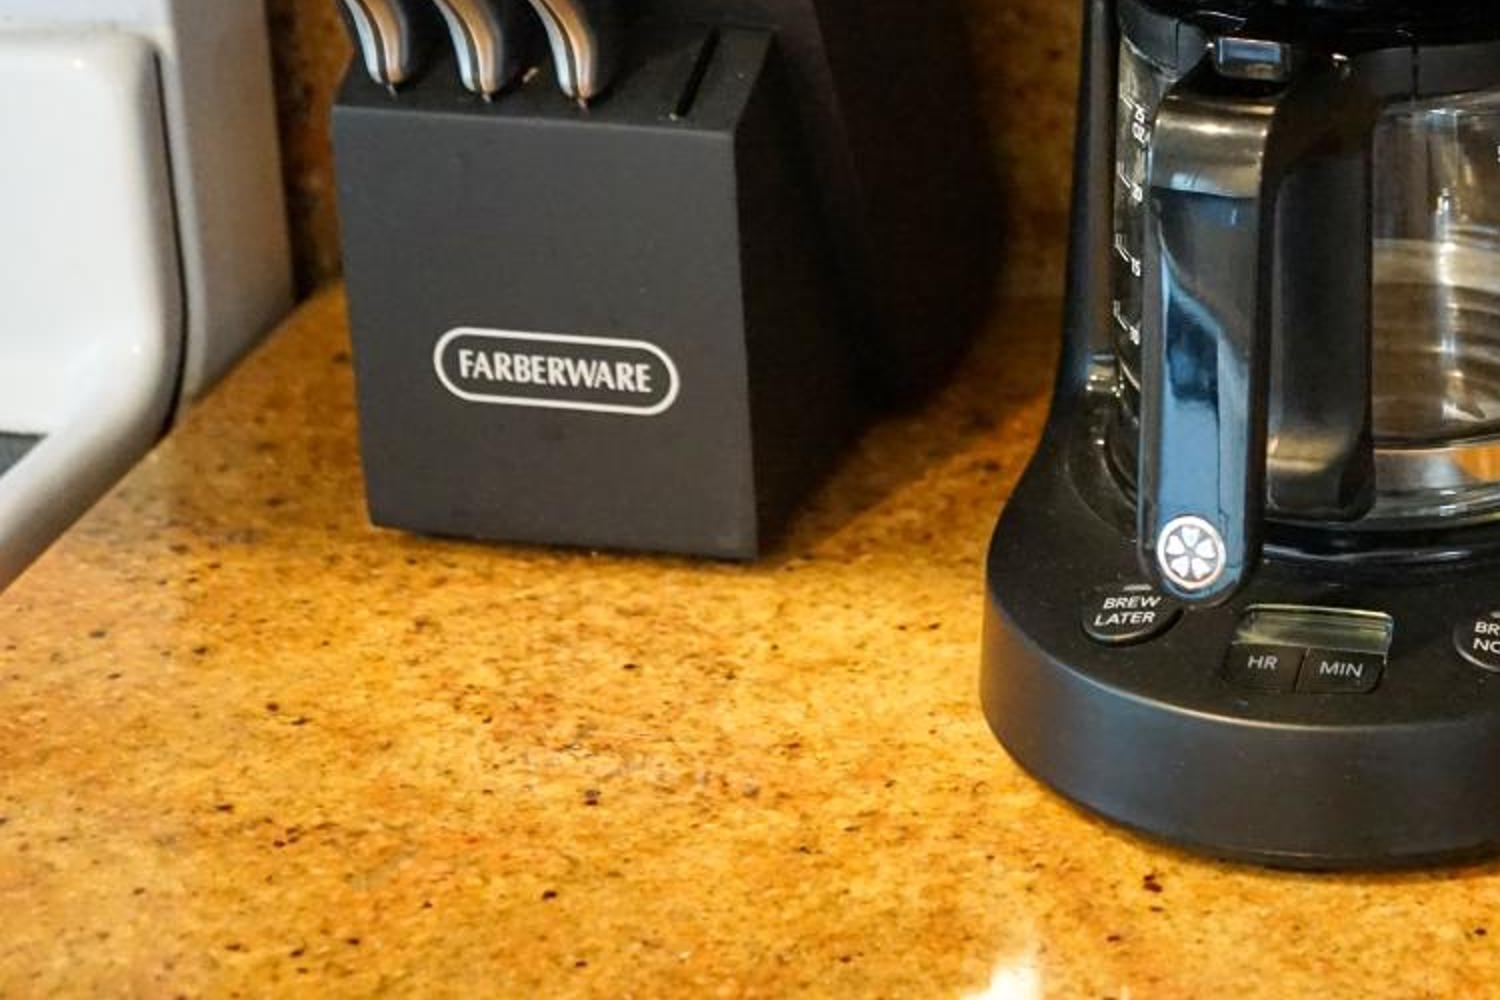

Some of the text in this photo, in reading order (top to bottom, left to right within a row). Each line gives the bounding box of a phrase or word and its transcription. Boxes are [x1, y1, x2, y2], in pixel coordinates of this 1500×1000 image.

[457, 348, 652, 393] FARBERWARE
[1102, 595, 1162, 610] BREW
[1093, 611, 1156, 627] LATER
[1247, 655, 1363, 679] HR MIN
